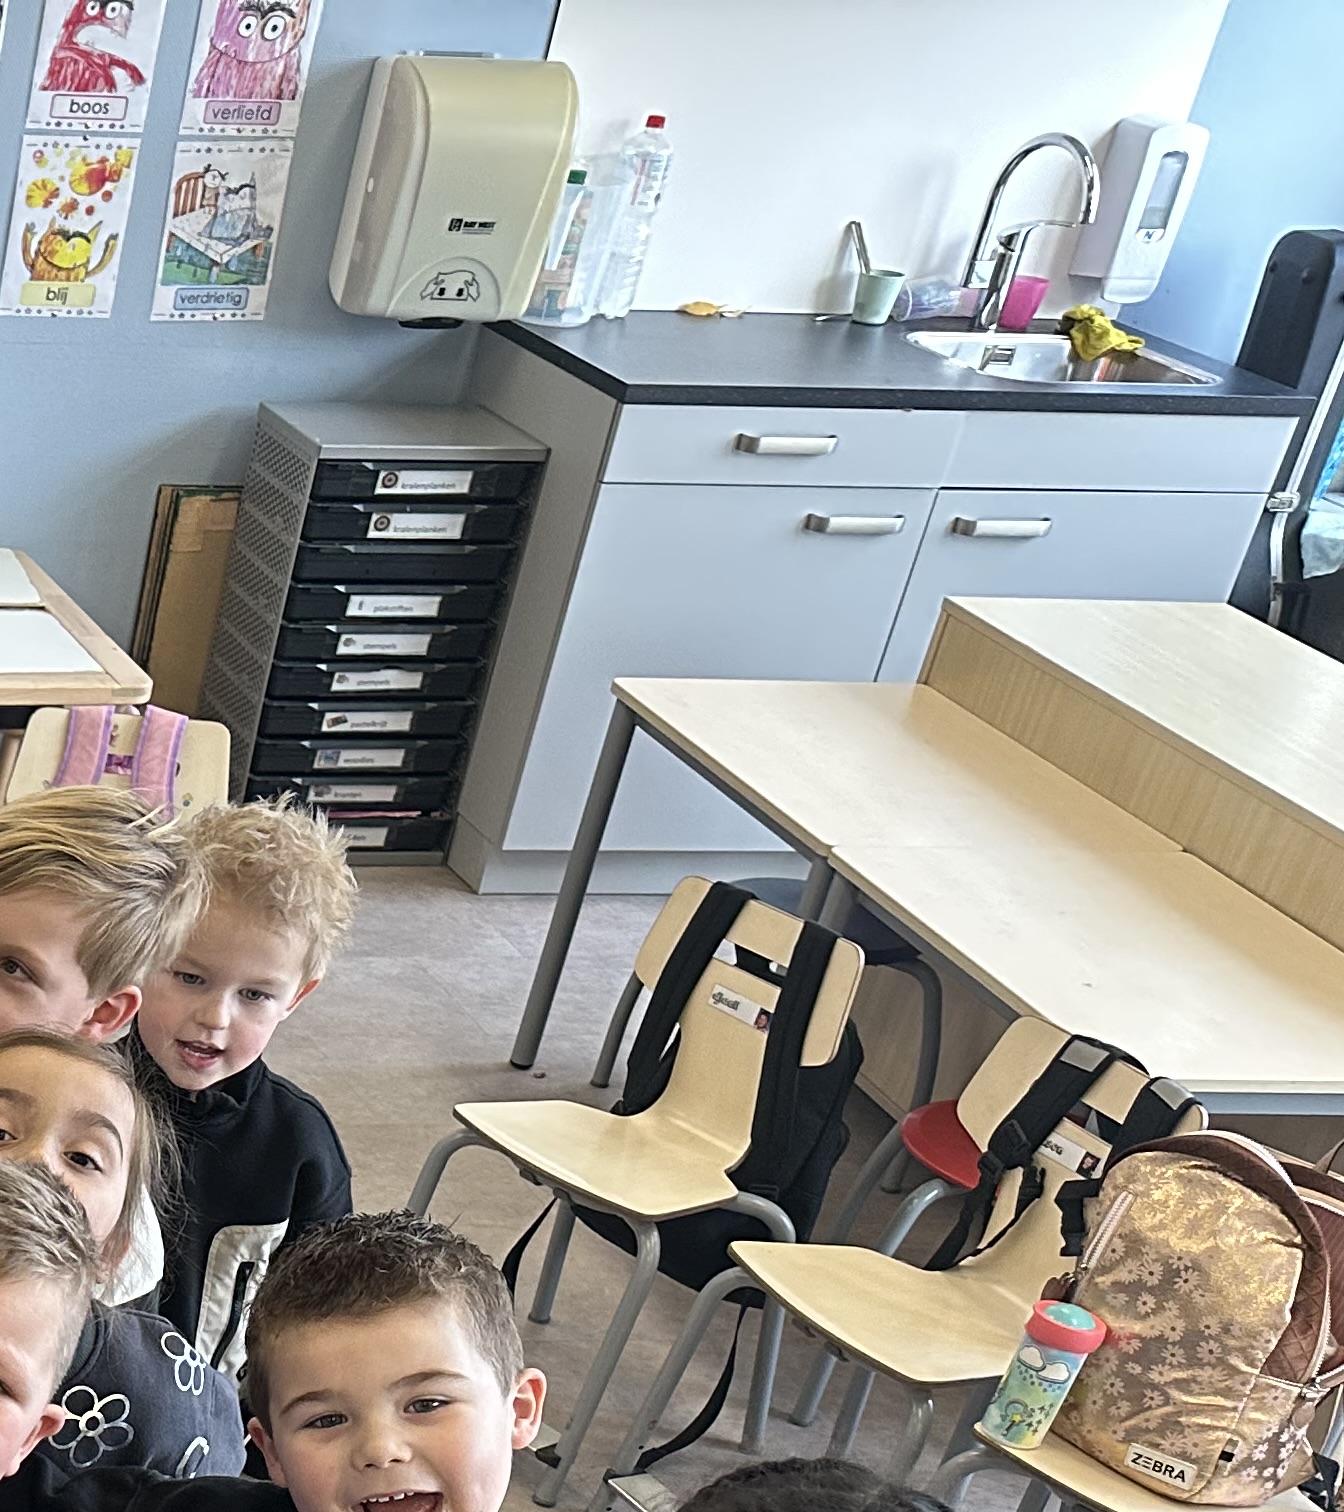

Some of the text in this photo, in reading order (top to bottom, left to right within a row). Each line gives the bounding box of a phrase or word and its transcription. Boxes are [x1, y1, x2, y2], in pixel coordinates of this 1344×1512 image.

[68, 98, 110, 116] boos
[210, 103, 273, 123] verliefd
[44, 285, 70, 306] blij
[177, 288, 243, 307] verdrietig
[1131, 1451, 1186, 1483] ZEBRA
